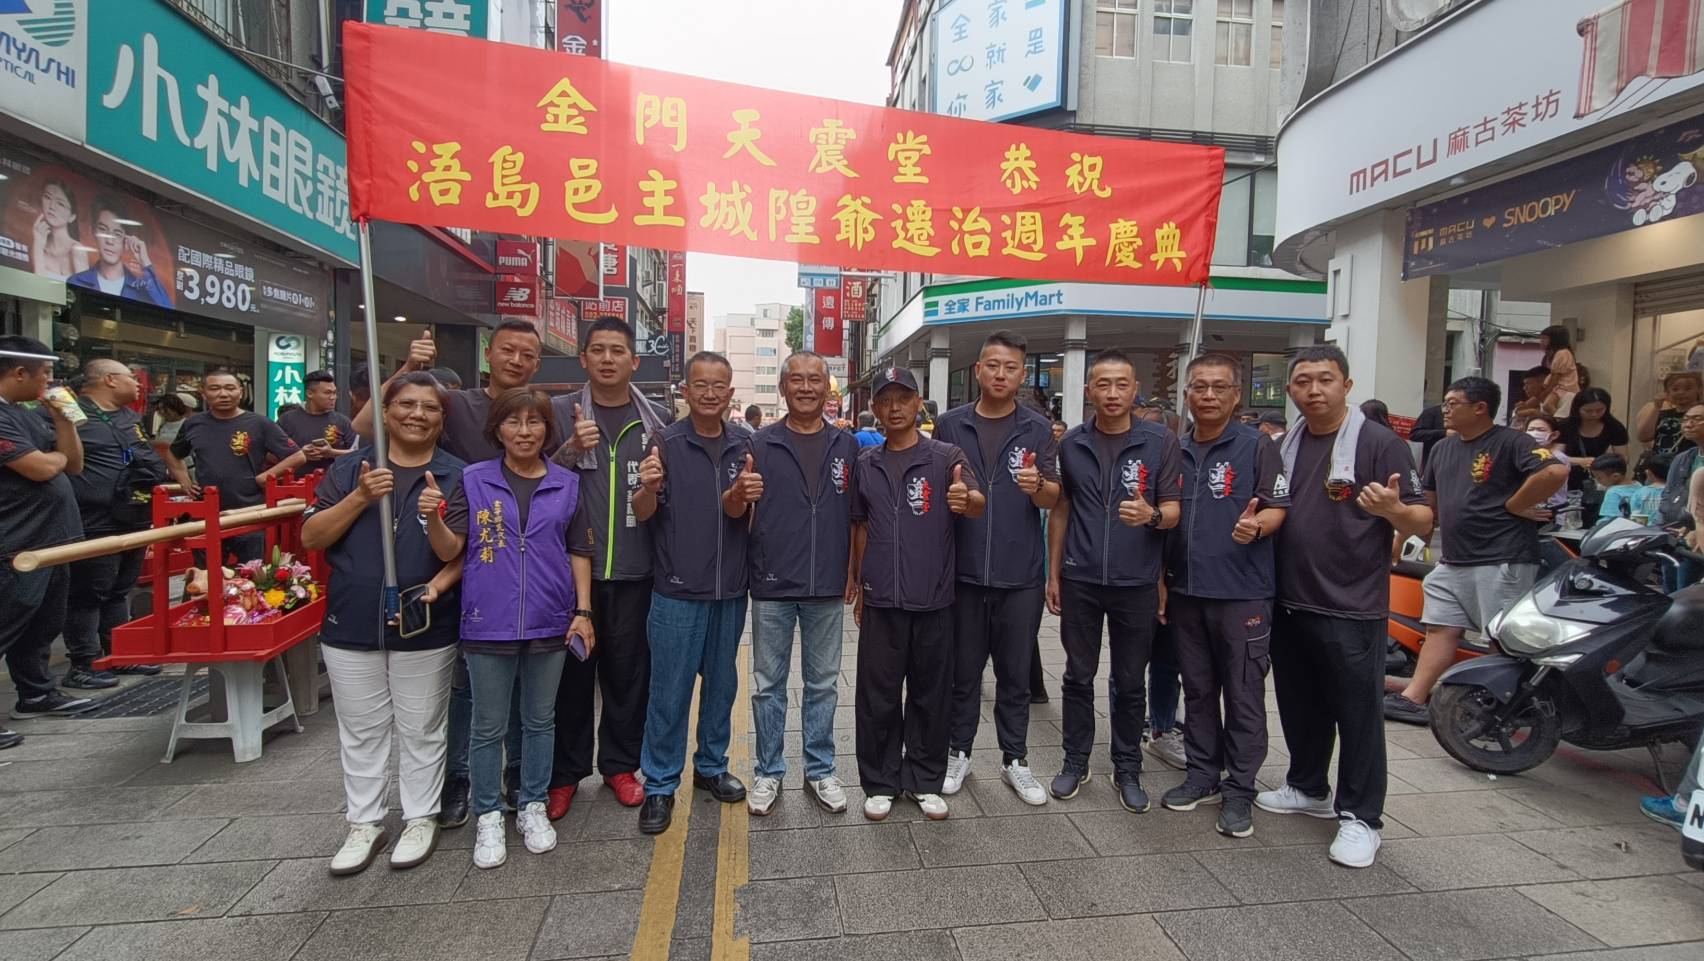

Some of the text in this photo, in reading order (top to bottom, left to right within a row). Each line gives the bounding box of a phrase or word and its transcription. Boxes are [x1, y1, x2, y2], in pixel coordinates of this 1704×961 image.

[103, 33, 356, 241] 小林眼鏡
[536, 77, 1113, 199] 金門天震堂 恭祝
[1349, 89, 1562, 196] MACU 麻古茶坊
[406, 141, 1188, 273] 浯島邑主城隍爺遷治週年慶典
[1439, 189, 1577, 237] MACU SNOOPY
[183, 269, 252, 312] 3,980
[498, 256, 528, 267] PUMA
[943, 289, 1063, 315] 全家 FamilyMart
